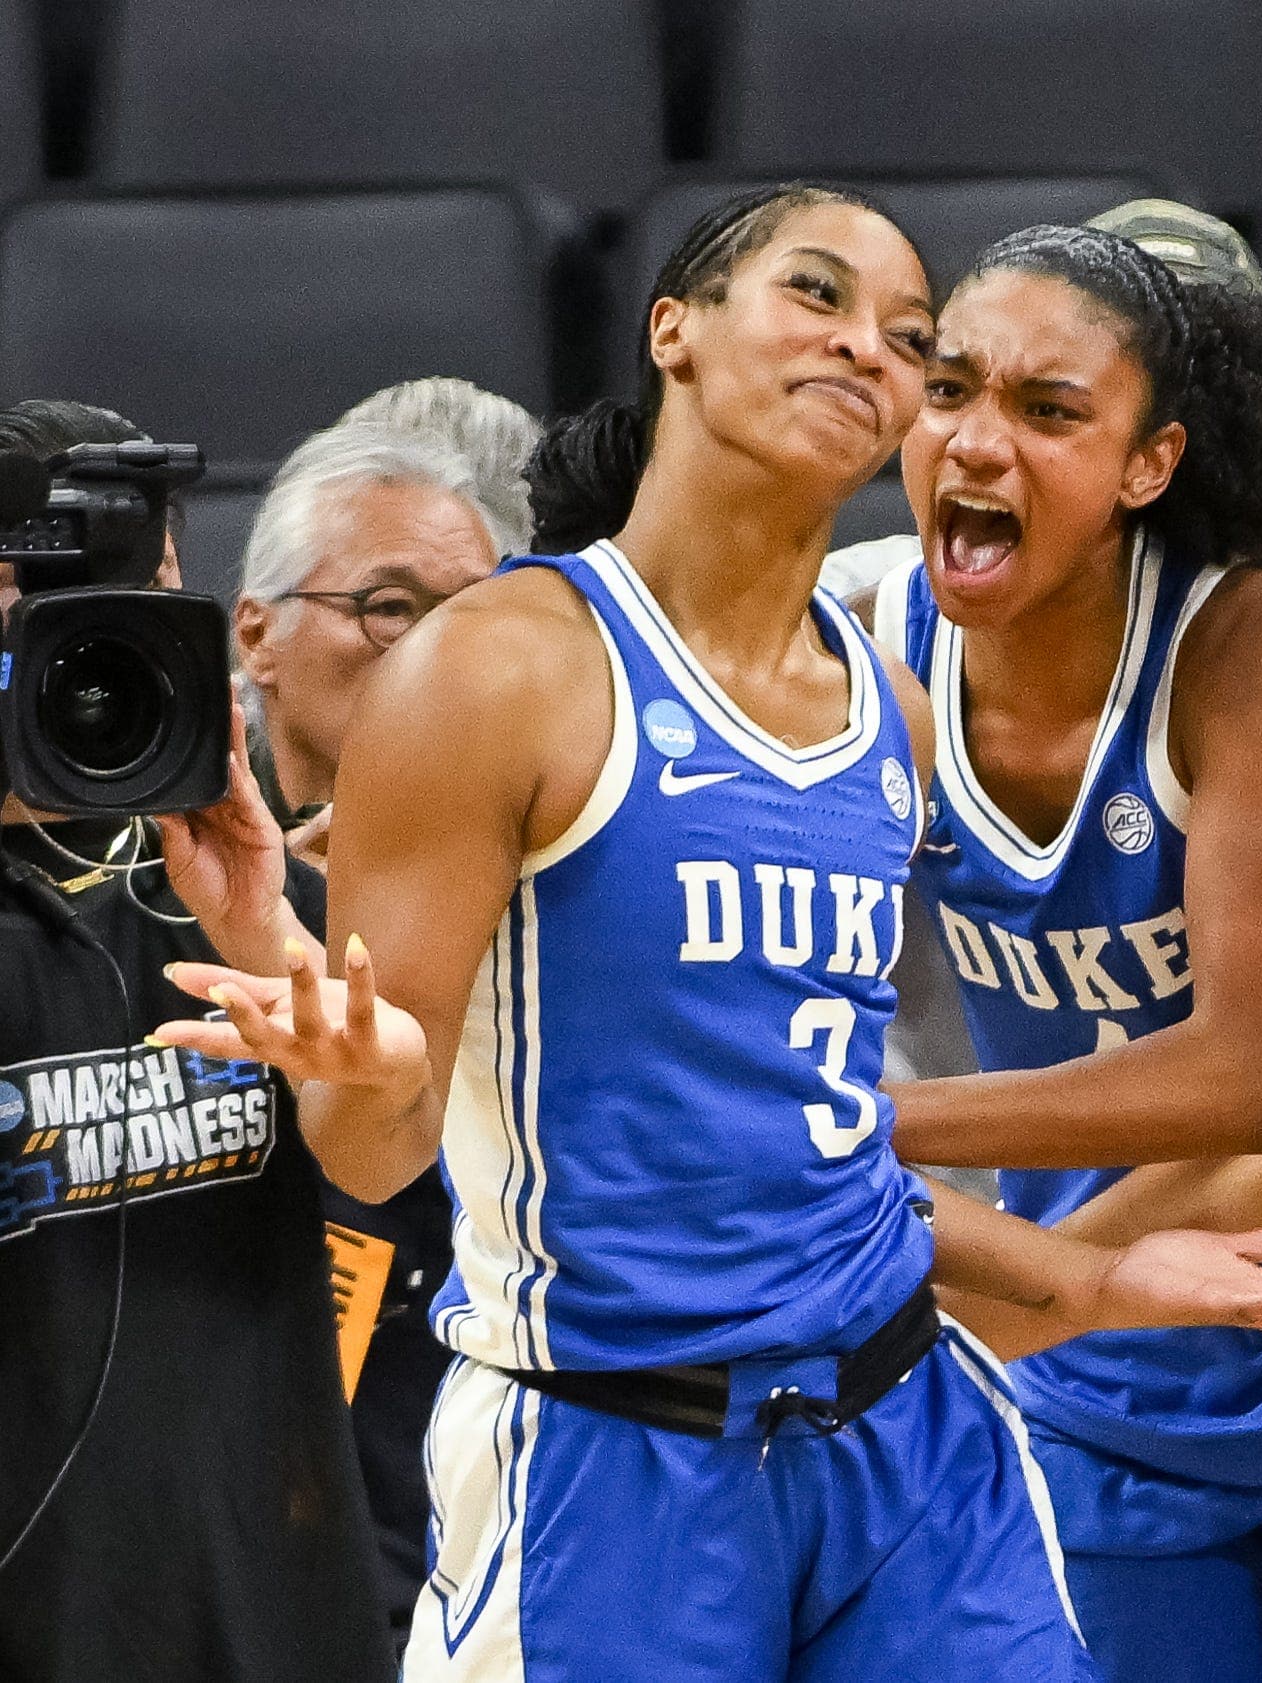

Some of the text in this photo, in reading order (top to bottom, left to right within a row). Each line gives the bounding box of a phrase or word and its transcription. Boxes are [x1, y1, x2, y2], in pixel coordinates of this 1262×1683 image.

[651, 724, 695, 745] NCAA
[1112, 810, 1147, 829] ACC
[676, 860, 904, 980] DUK
[938, 899, 1196, 1011] DUKE
[28, 1046, 186, 1129] MARCH
[789, 997, 878, 1158] 3
[66, 1087, 268, 1185] MADNESS
